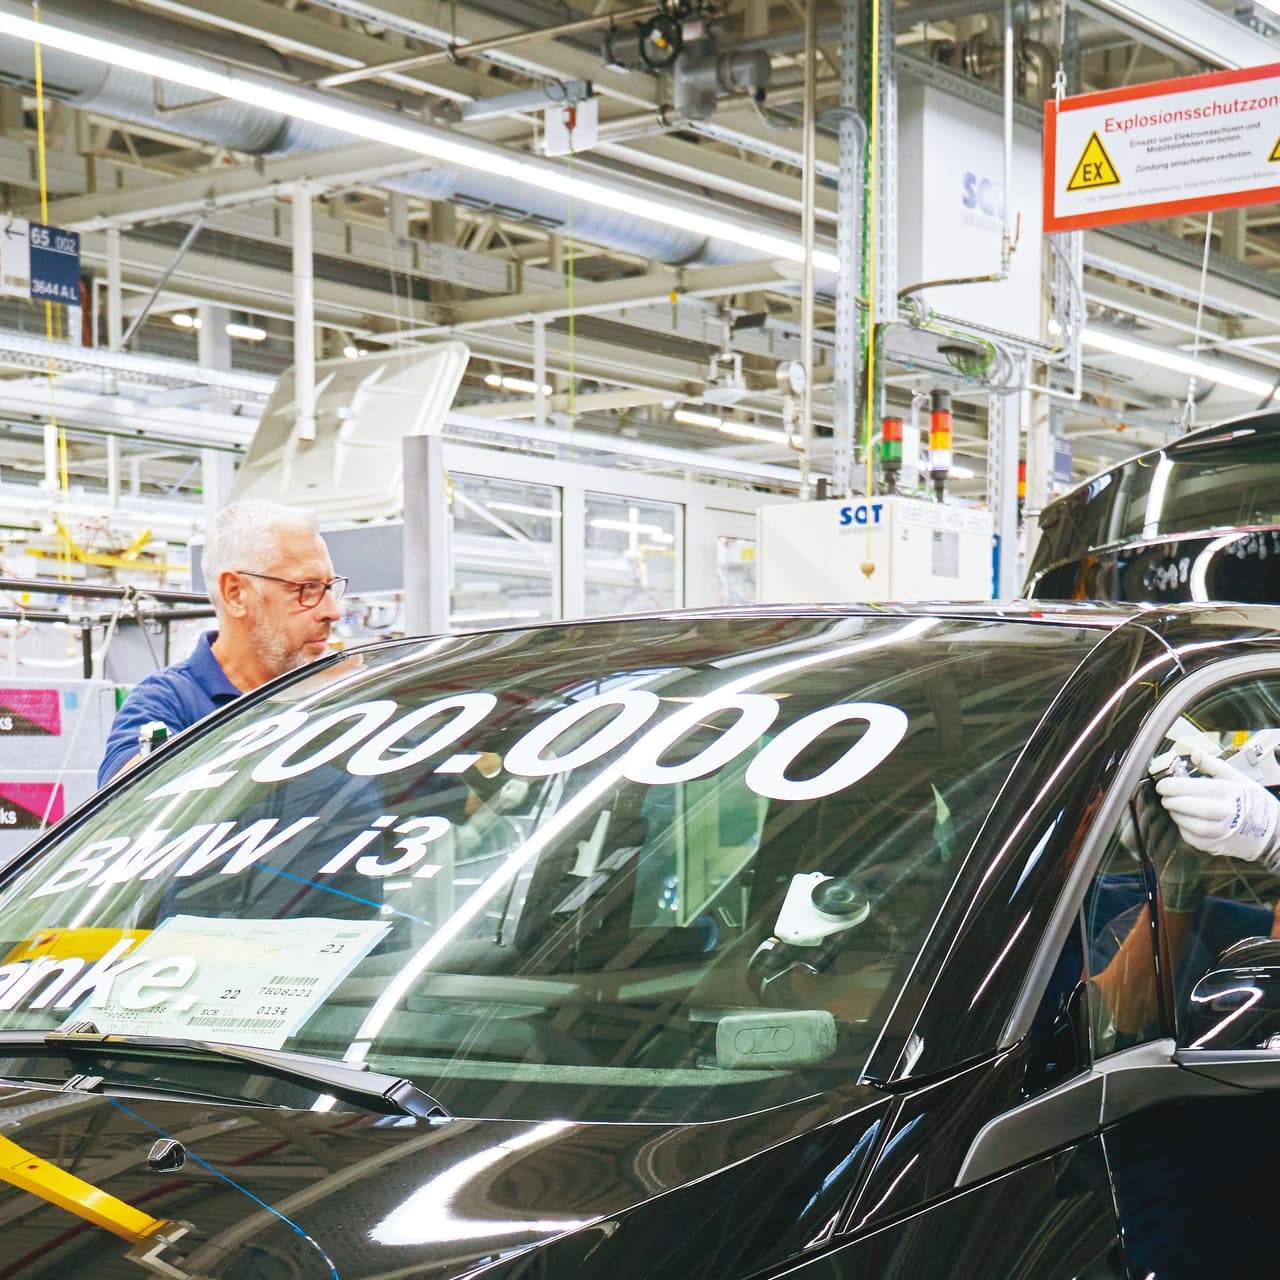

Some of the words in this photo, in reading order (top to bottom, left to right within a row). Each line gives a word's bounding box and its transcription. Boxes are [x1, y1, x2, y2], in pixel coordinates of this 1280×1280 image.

[1245, 122, 1261, 131] und
[1082, 162, 1104, 182] EX
[31, 228, 51, 247] 65
[146, 690, 909, 801] 200.000
[31, 814, 320, 901] BMW
[320, 943, 345, 954] 21
[220, 989, 241, 1000] 22
[256, 1006, 288, 1016] 0134
